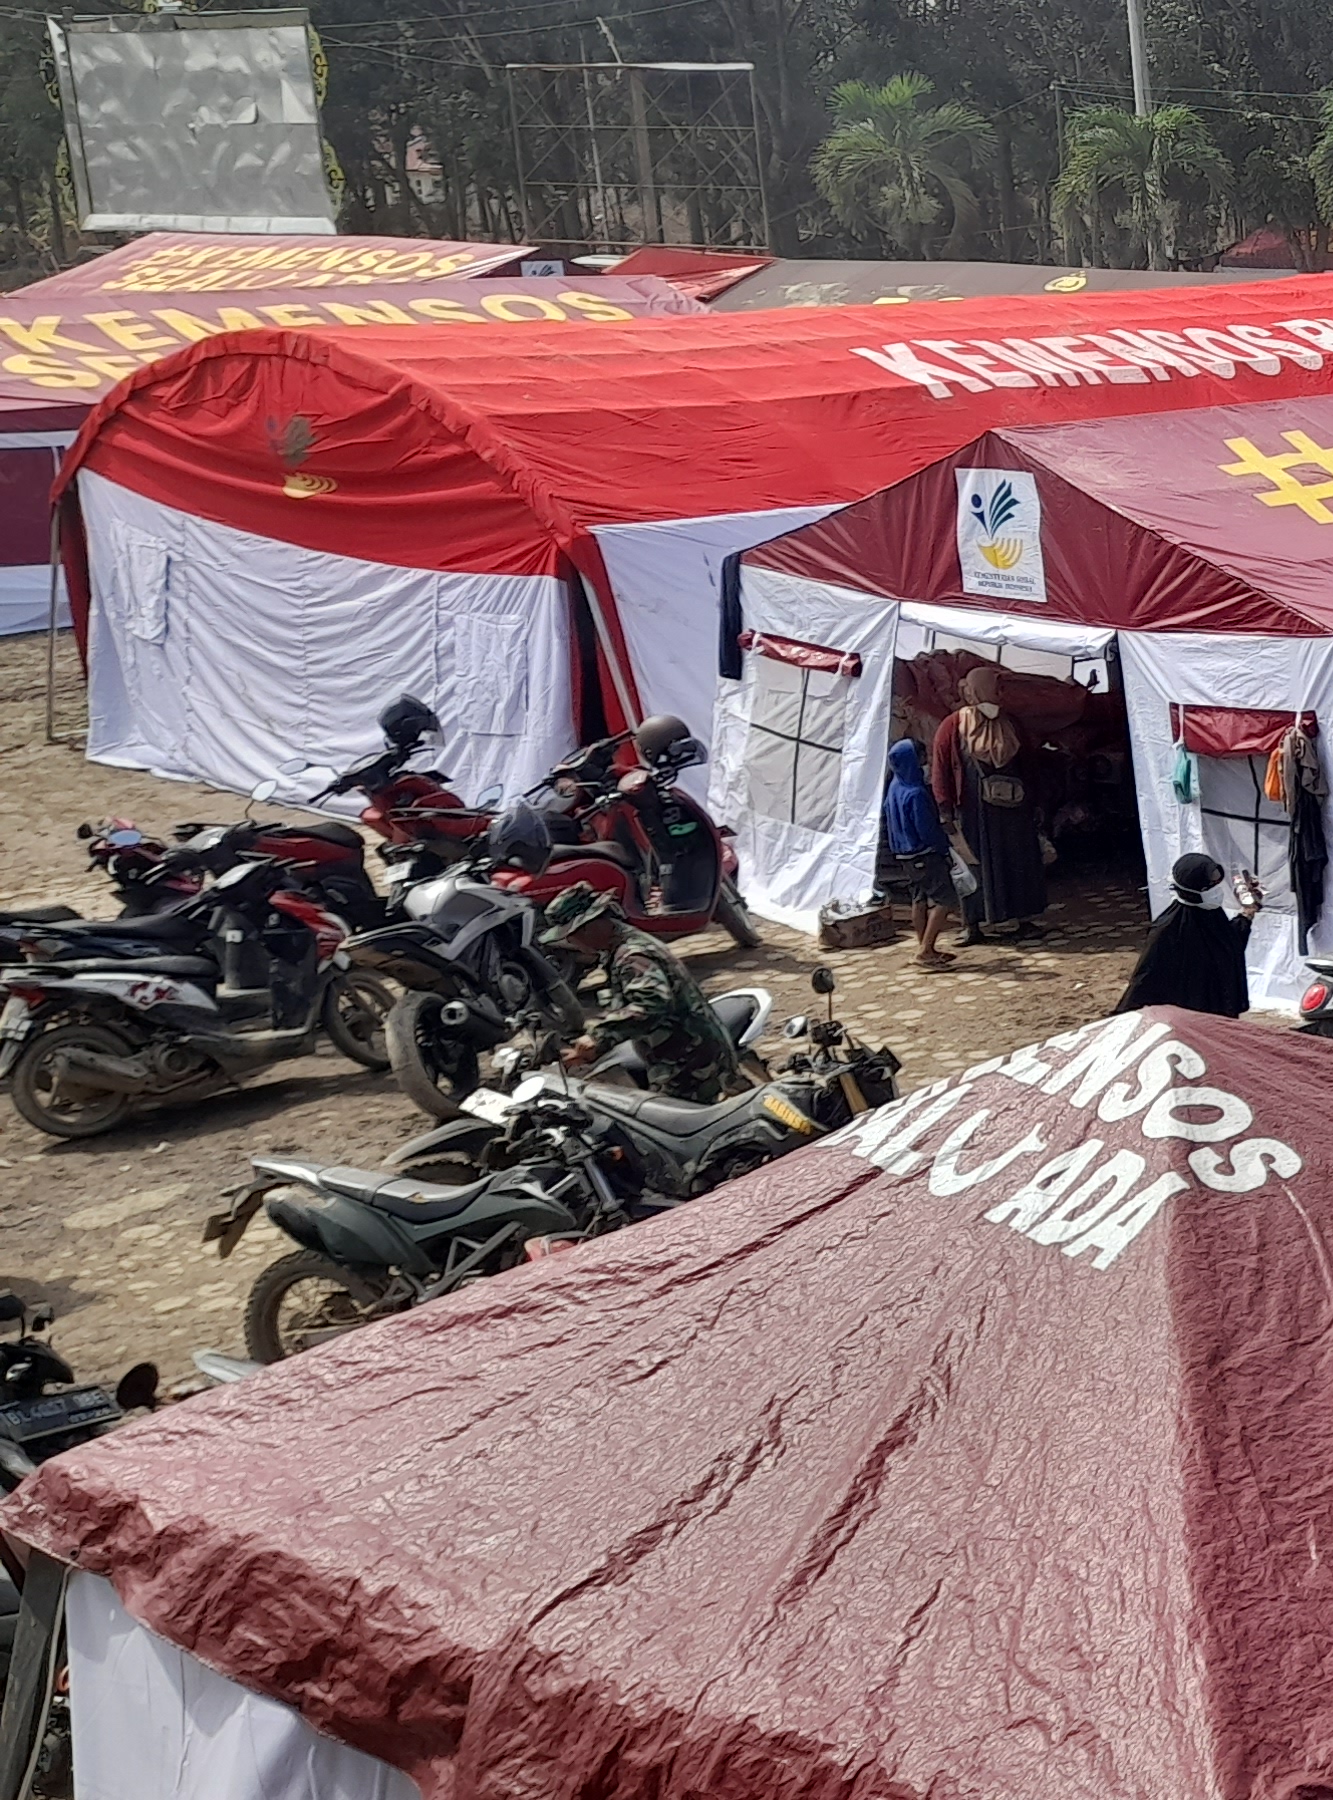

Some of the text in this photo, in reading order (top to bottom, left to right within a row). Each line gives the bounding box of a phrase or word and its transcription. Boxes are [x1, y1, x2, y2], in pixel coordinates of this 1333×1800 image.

[118, 244, 476, 278] #KEMENSOS
[849, 334, 1324, 399] KEMENSOS
[958, 1011, 1304, 1193] ENSOS
[982, 1138, 1191, 1271] ADA
